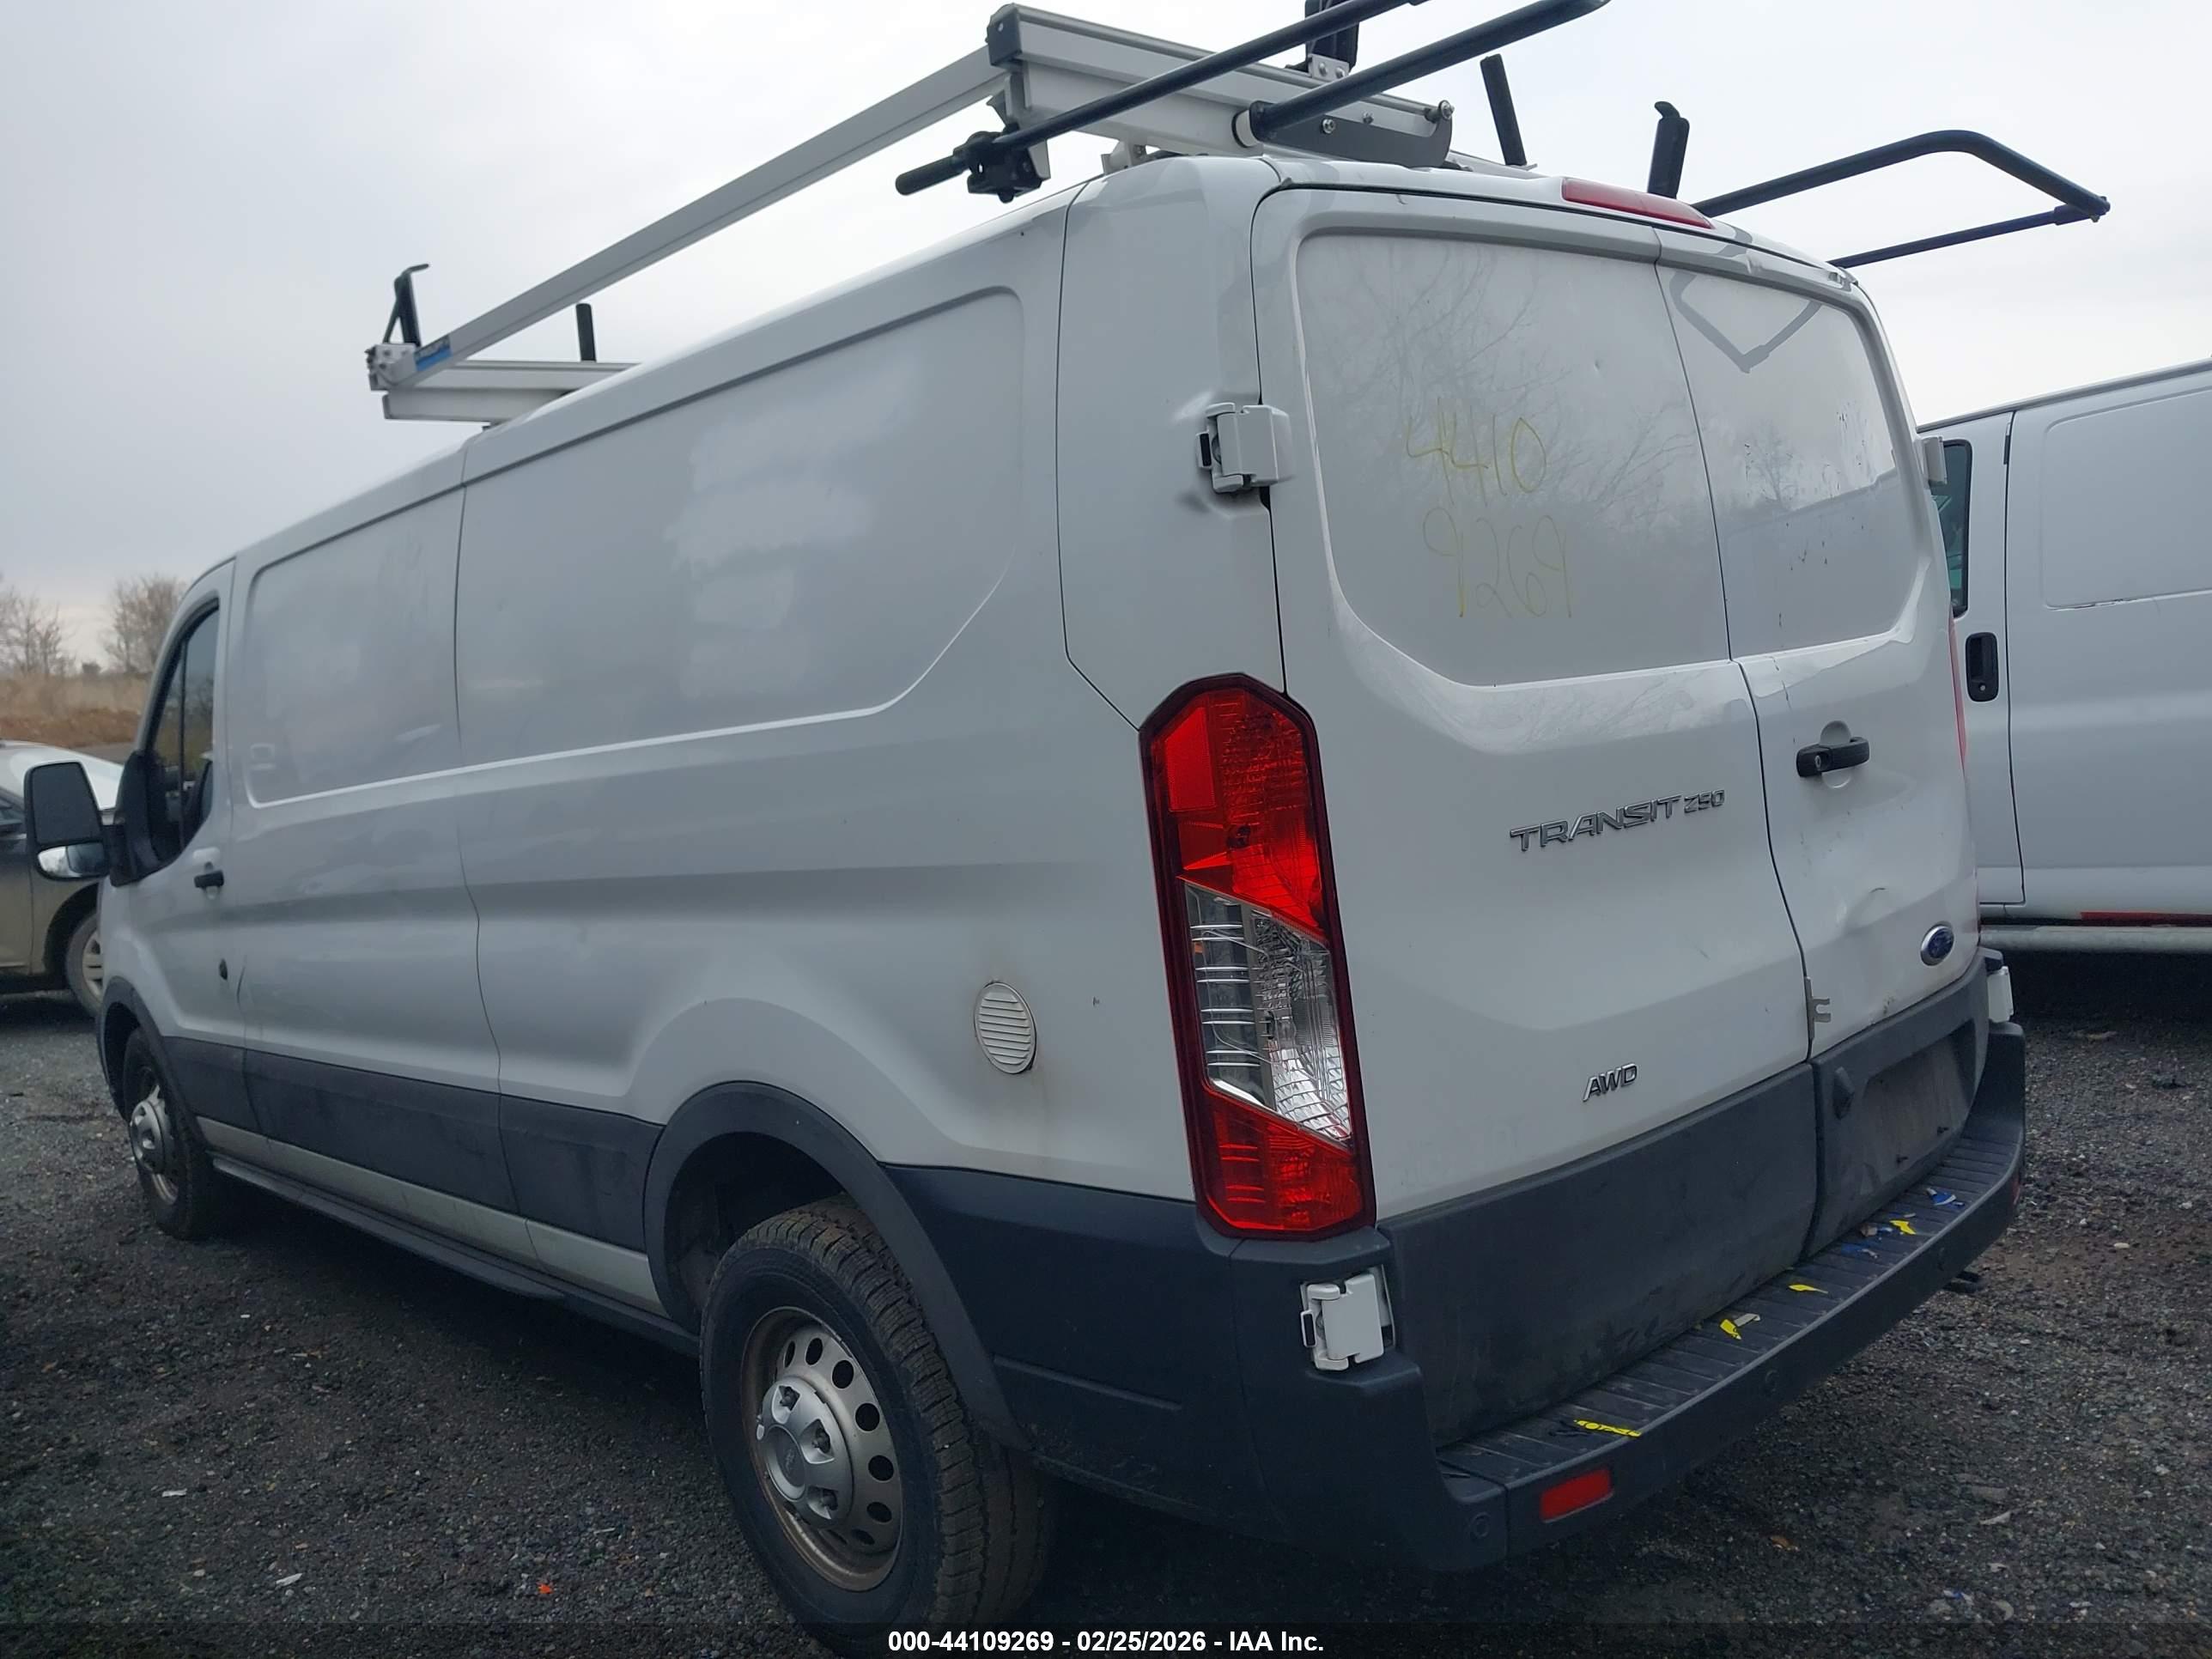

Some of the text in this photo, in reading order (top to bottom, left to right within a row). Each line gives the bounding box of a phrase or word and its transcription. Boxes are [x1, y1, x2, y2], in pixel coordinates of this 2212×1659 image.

[1406, 398, 1546, 507] 4410
[1423, 507, 1571, 617] 9269
[1510, 788, 1724, 852] TRANSIT 250
[1583, 1062, 1638, 1103] AWD
